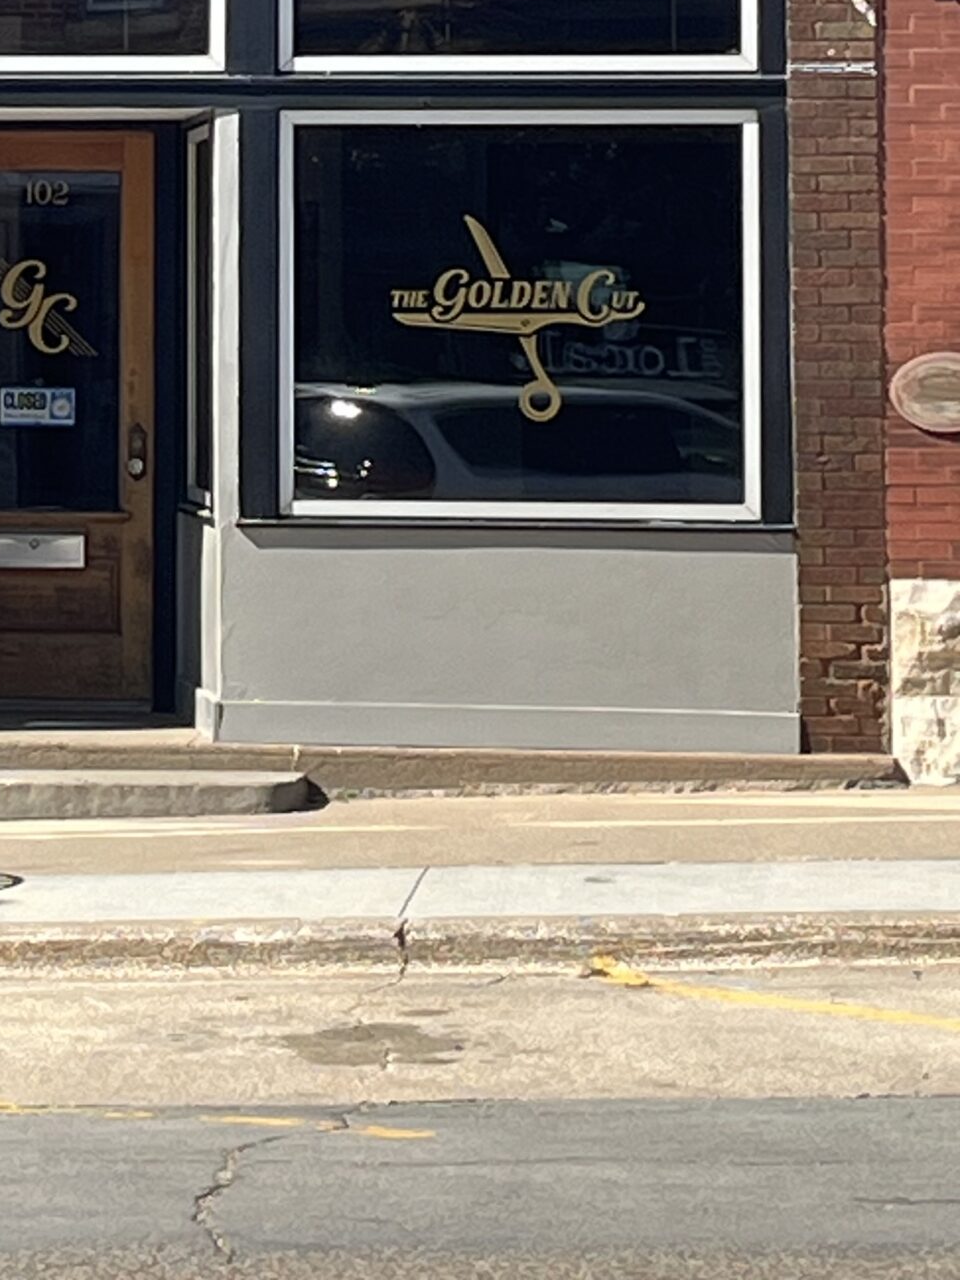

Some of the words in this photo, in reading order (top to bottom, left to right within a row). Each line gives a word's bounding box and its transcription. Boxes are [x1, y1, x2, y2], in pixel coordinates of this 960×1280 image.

[25, 179, 70, 206] 102
[390, 289, 429, 309] THE
[431, 269, 571, 321] GOLDEN
[577, 270, 640, 321] CUT
[3, 392, 48, 410] CLOSED
